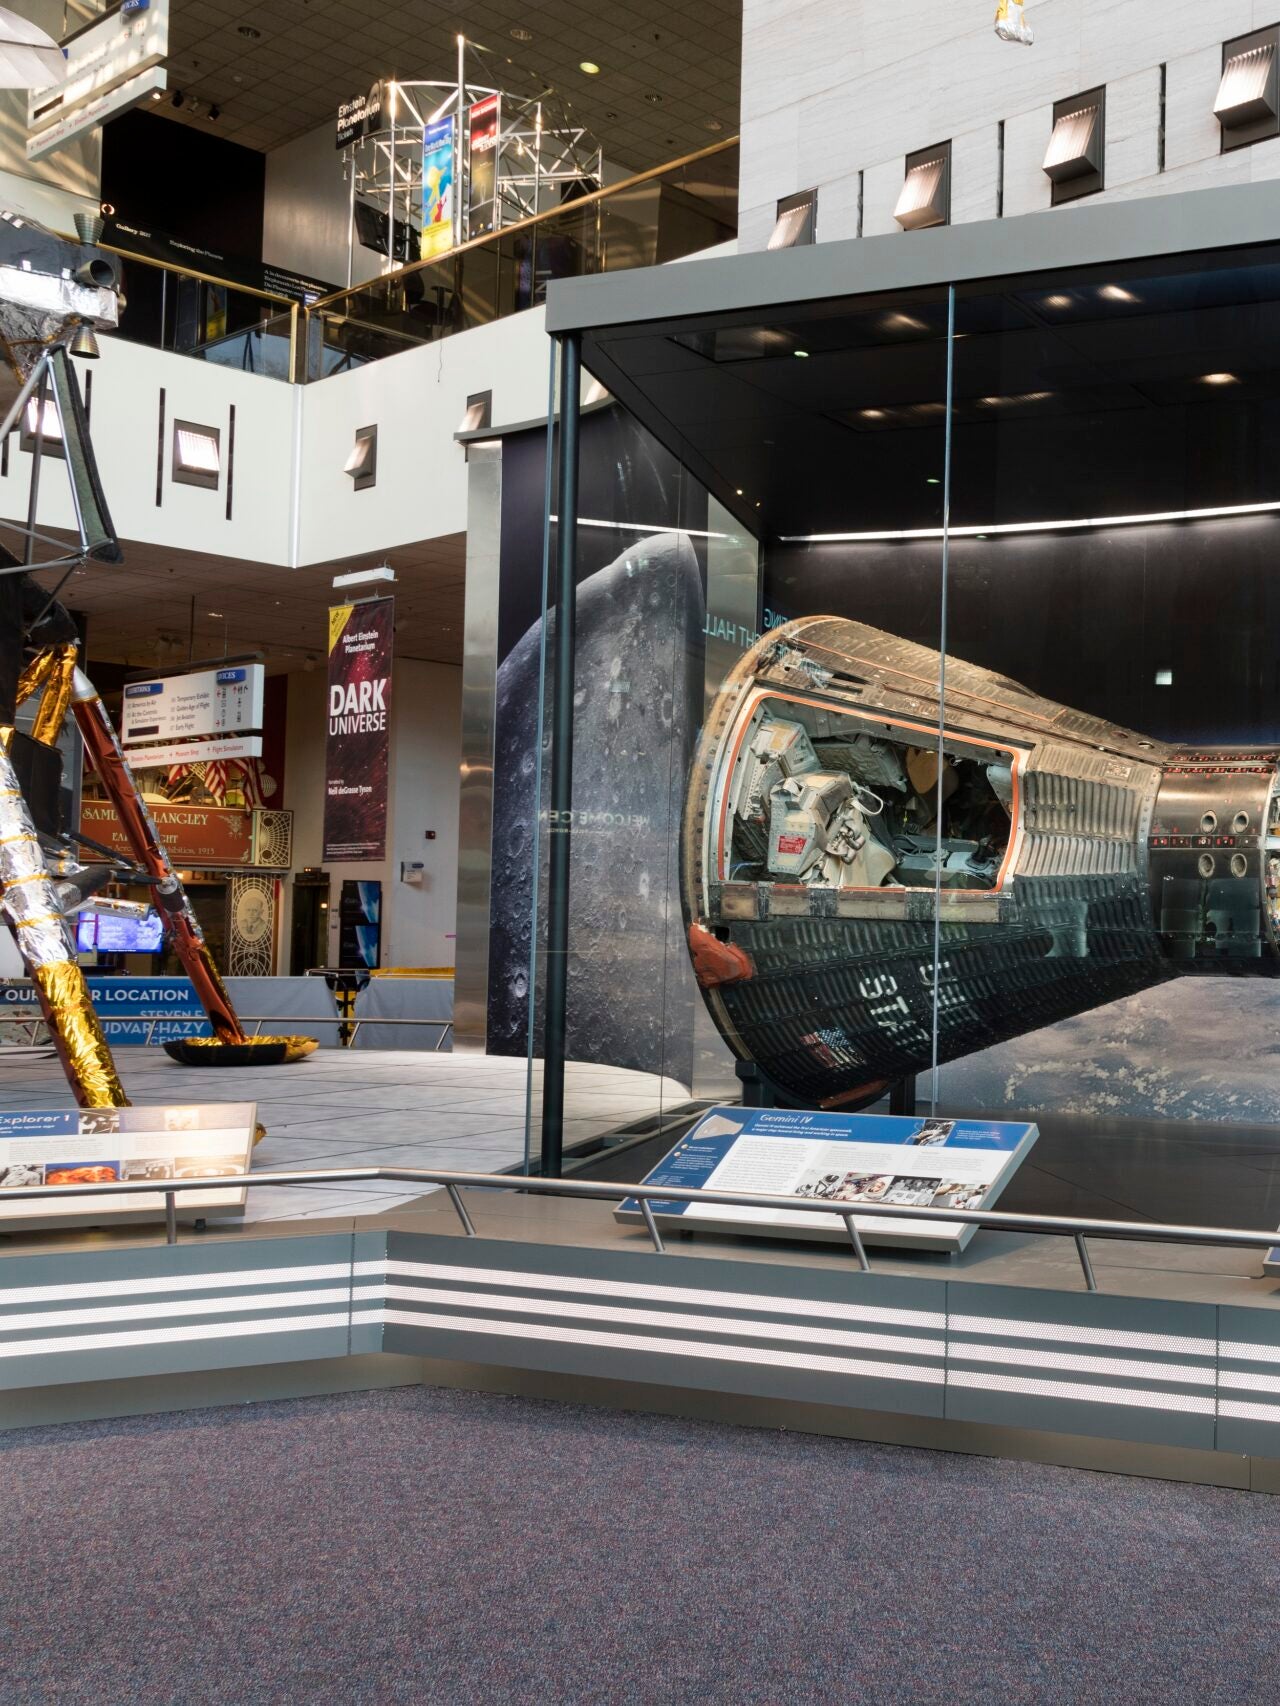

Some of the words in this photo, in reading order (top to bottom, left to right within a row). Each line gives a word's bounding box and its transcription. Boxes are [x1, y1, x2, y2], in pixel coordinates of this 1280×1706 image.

[338, 95, 366, 118] Einstein
[337, 102, 380, 132] Planetarium
[115, 223, 138, 235] Gallery
[343, 634, 358, 644] Albert
[358, 629, 379, 641] Einstein
[345, 642, 376, 654] Planetarium
[330, 678, 387, 717] DARK
[329, 711, 386, 736] UNIVERSE
[328, 786, 338, 795] Neil
[338, 786, 359, 795] deGrasse
[359, 785, 373, 796] Tyson
[153, 811, 208, 826] LANGLEY
[105, 990, 189, 1001] LOCATION
[64, 1114, 70, 1122] 1
[760, 1113, 800, 1124] Gemini
[800, 1116, 814, 1124] IV
